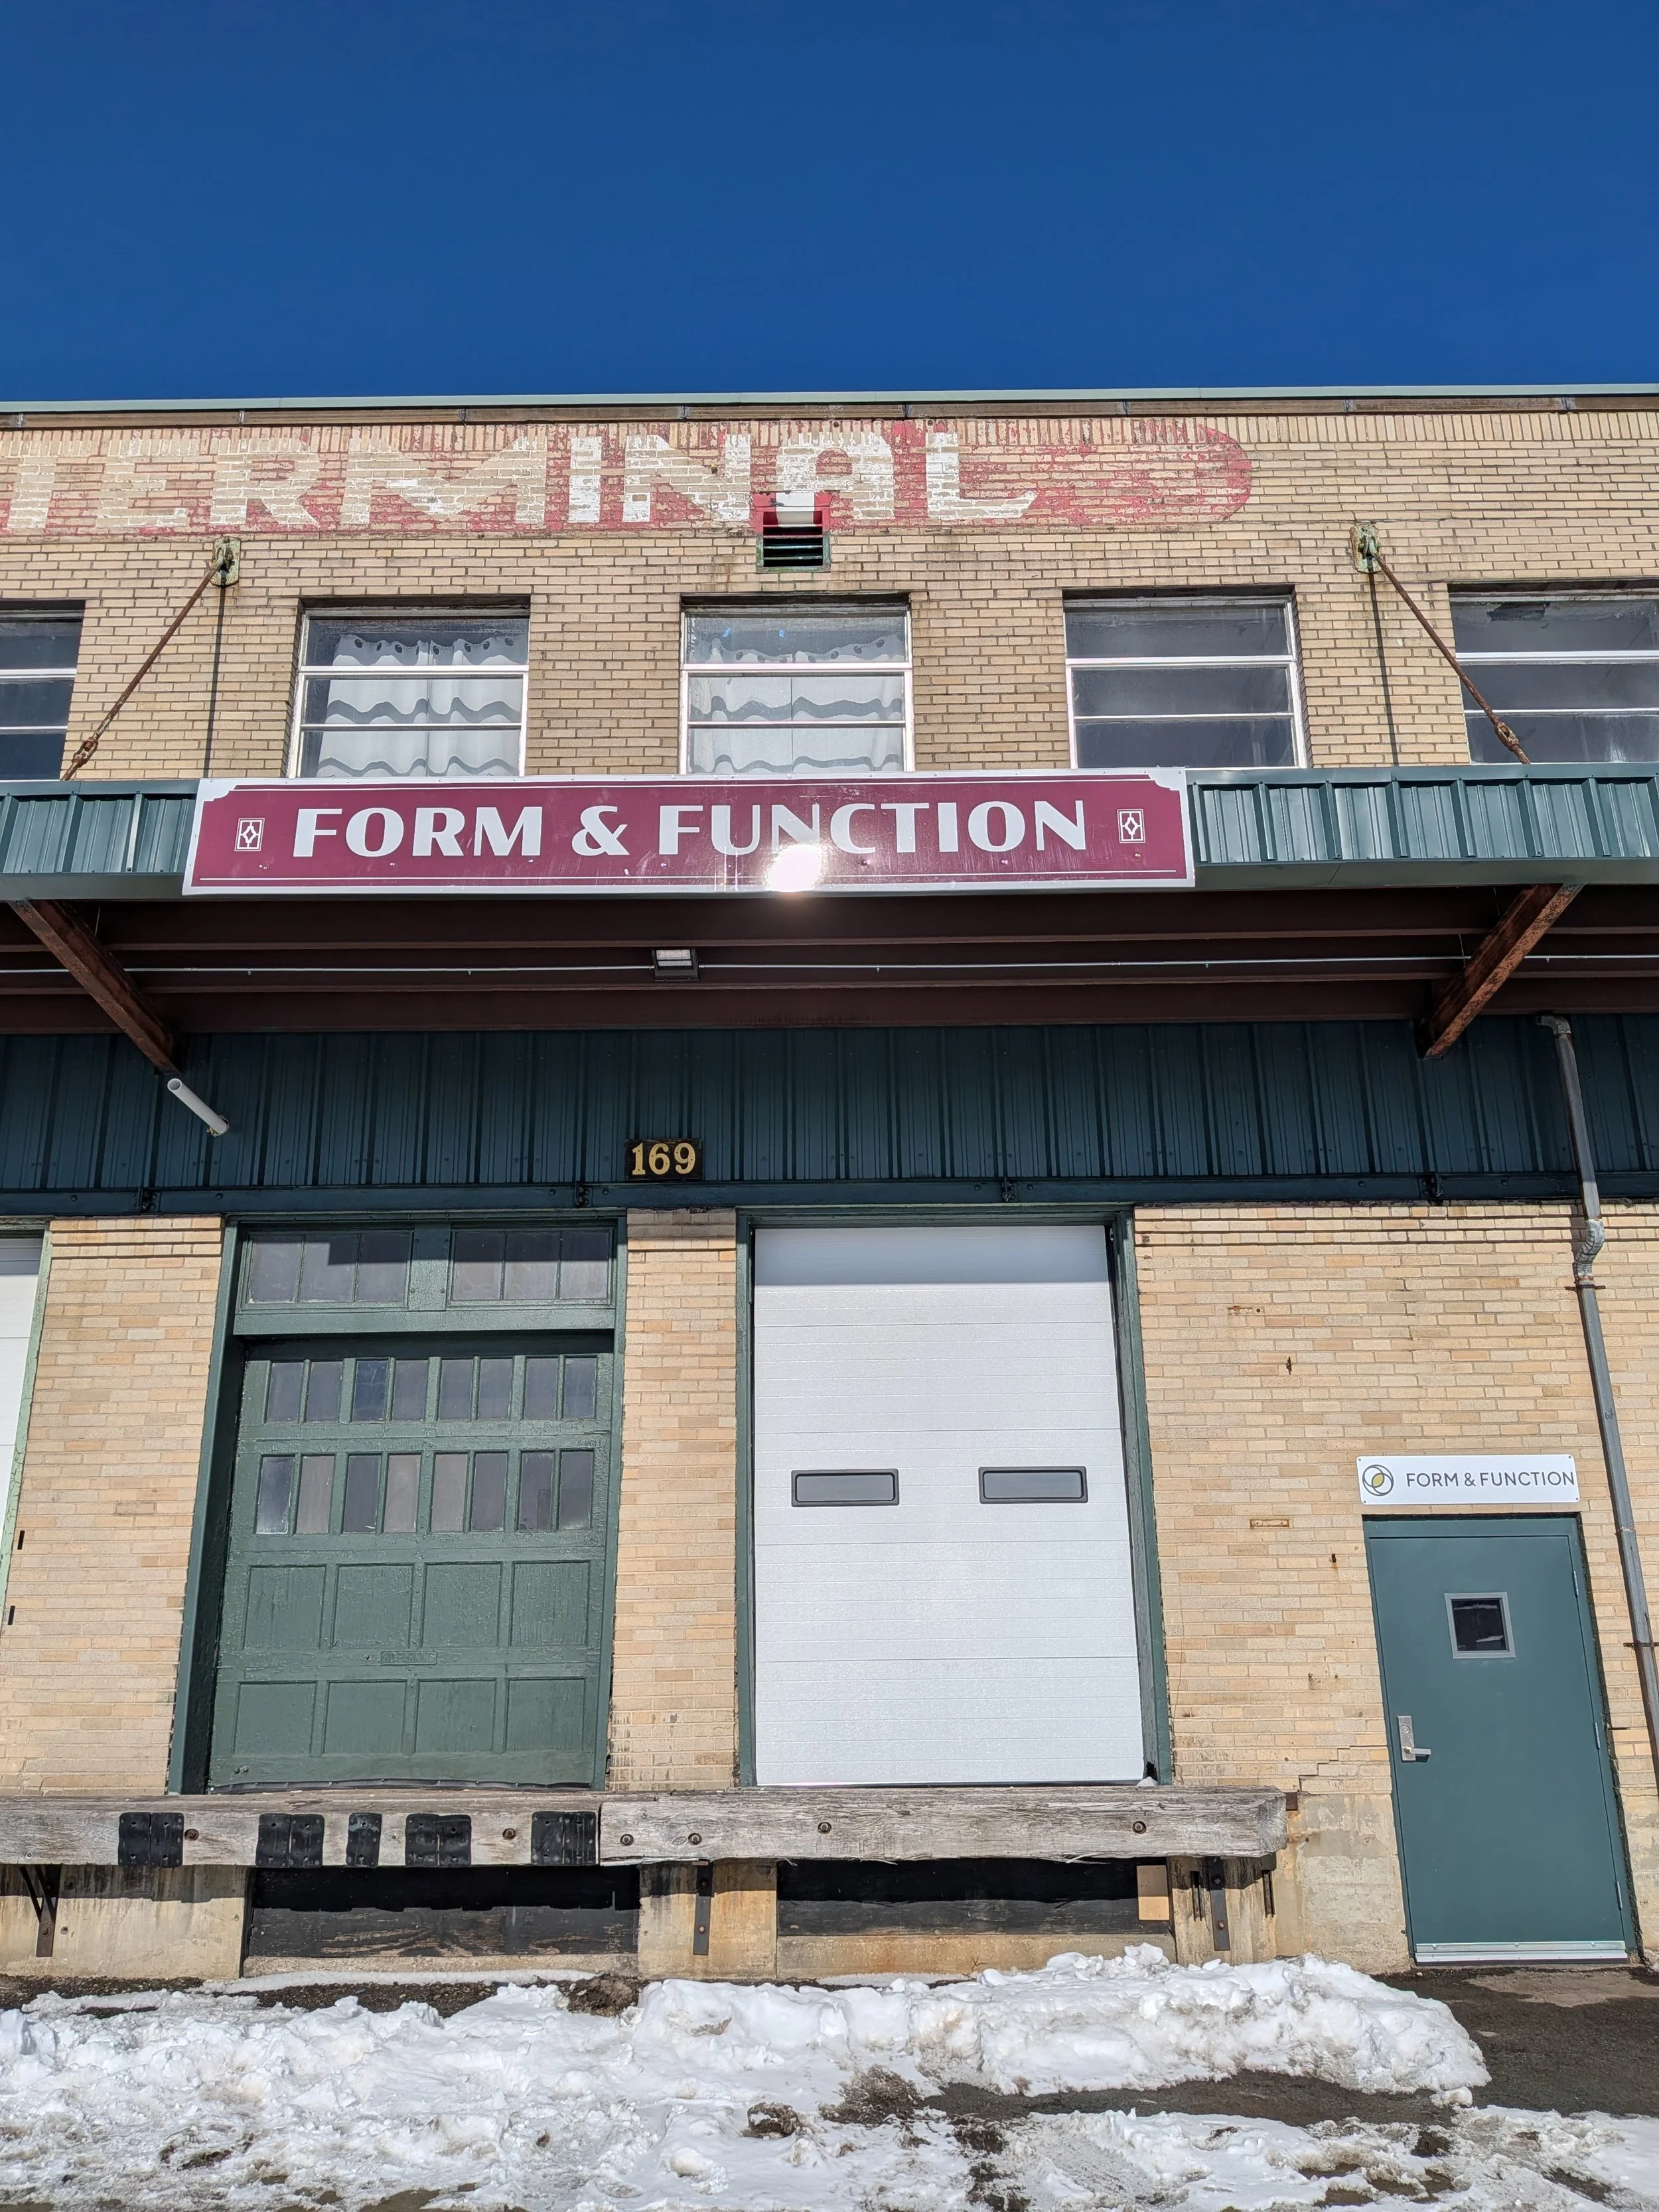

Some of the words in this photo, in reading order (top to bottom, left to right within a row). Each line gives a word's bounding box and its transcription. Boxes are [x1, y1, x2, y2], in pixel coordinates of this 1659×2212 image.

[293, 806, 543, 857] FORM
[571, 806, 630, 857] &
[659, 800, 1087, 855] FUNCTION
[632, 1142, 695, 1175] 169
[1406, 1473, 1459, 1487] FORM
[1464, 1472, 1476, 1487] &
[1480, 1471, 1575, 1487] FUNCTION
